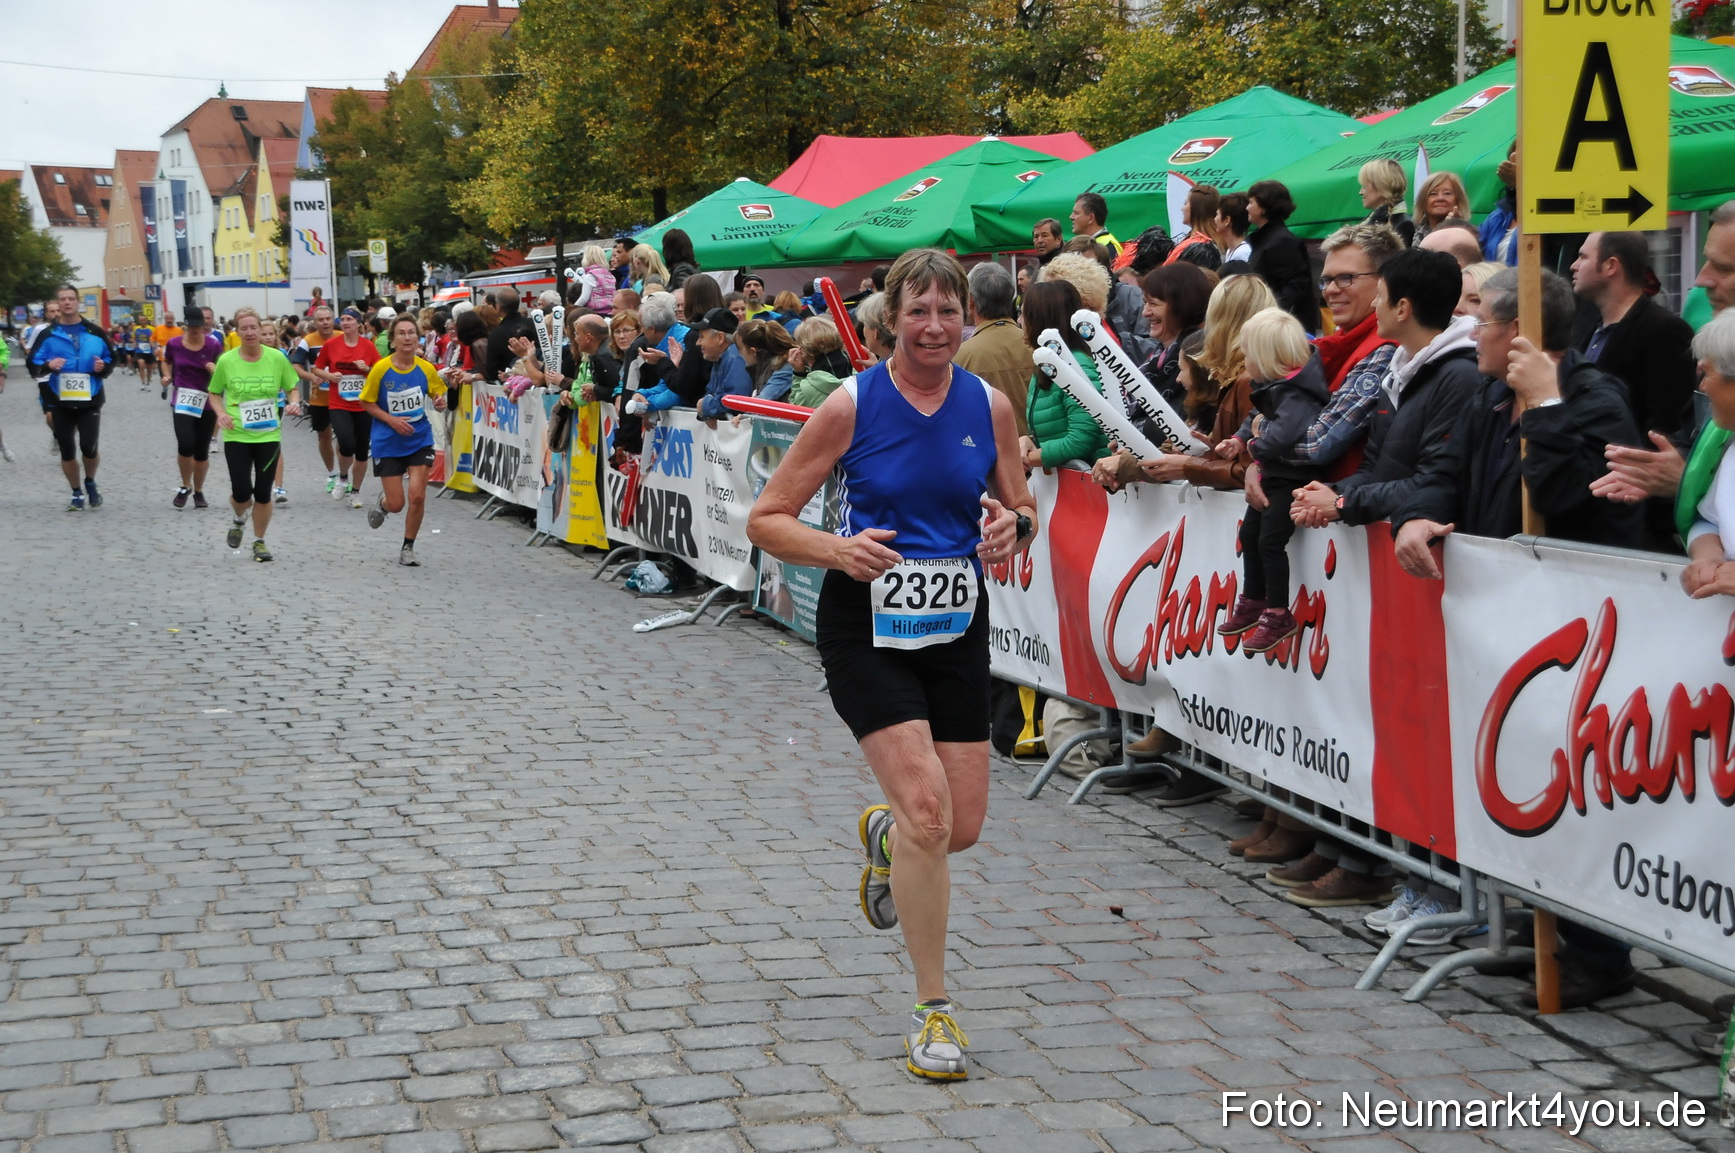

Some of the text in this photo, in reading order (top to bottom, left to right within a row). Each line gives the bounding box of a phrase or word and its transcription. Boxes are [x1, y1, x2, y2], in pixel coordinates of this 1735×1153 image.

[1554, 41, 1639, 172] A
[1082, 177, 1240, 194] Lammsräu
[724, 223, 797, 232] Neumarkte
[65, 379, 85, 390] 624
[341, 380, 364, 391] 2393
[180, 394, 203, 407] 2761
[391, 395, 421, 412] 2104
[1096, 345, 1192, 453] BMW Laufsport
[245, 406, 273, 422] 2541
[883, 572, 969, 609] 2326
[892, 617, 953, 635] Hildegard
[1013, 628, 1050, 667] Radio
[1292, 725, 1350, 783] Radio
